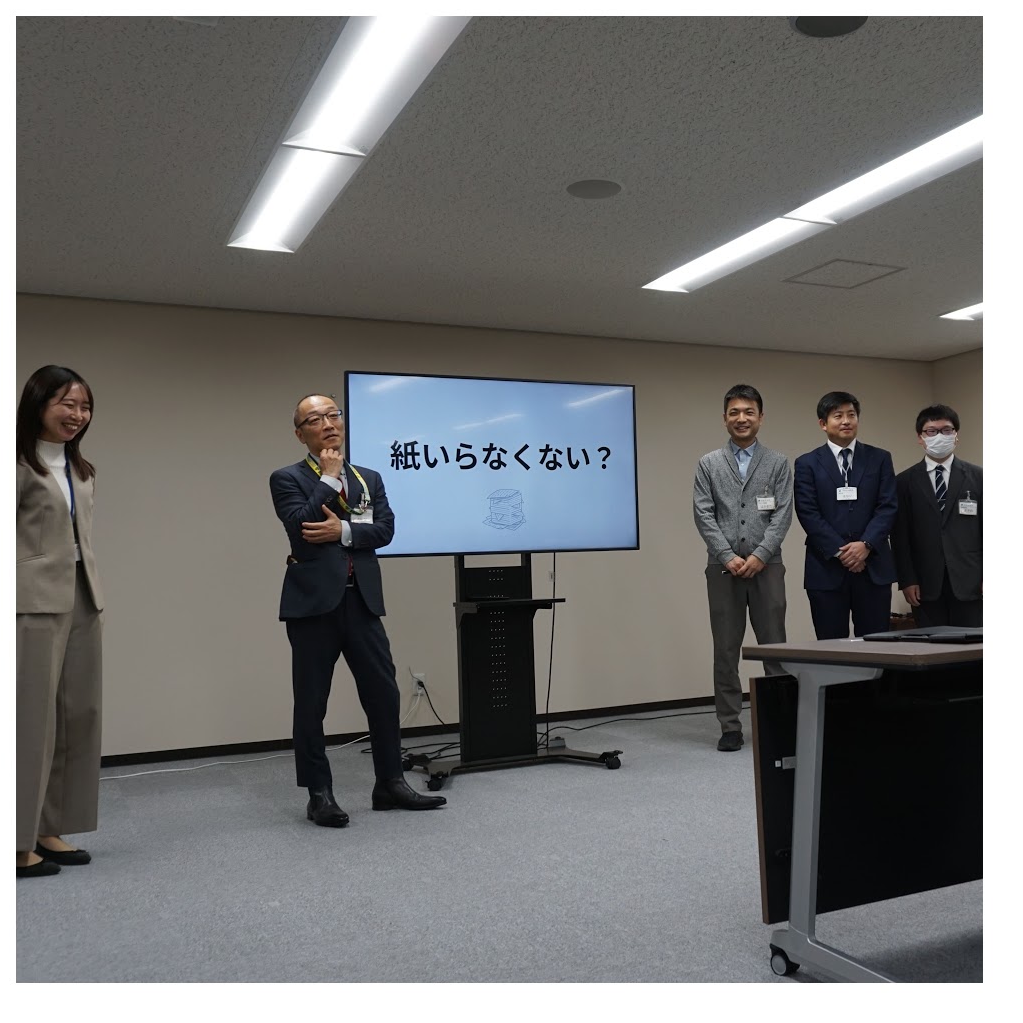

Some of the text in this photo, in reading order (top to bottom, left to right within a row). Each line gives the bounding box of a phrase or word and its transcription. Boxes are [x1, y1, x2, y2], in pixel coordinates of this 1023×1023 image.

[390, 439, 612, 471] 紙いらなくない？
